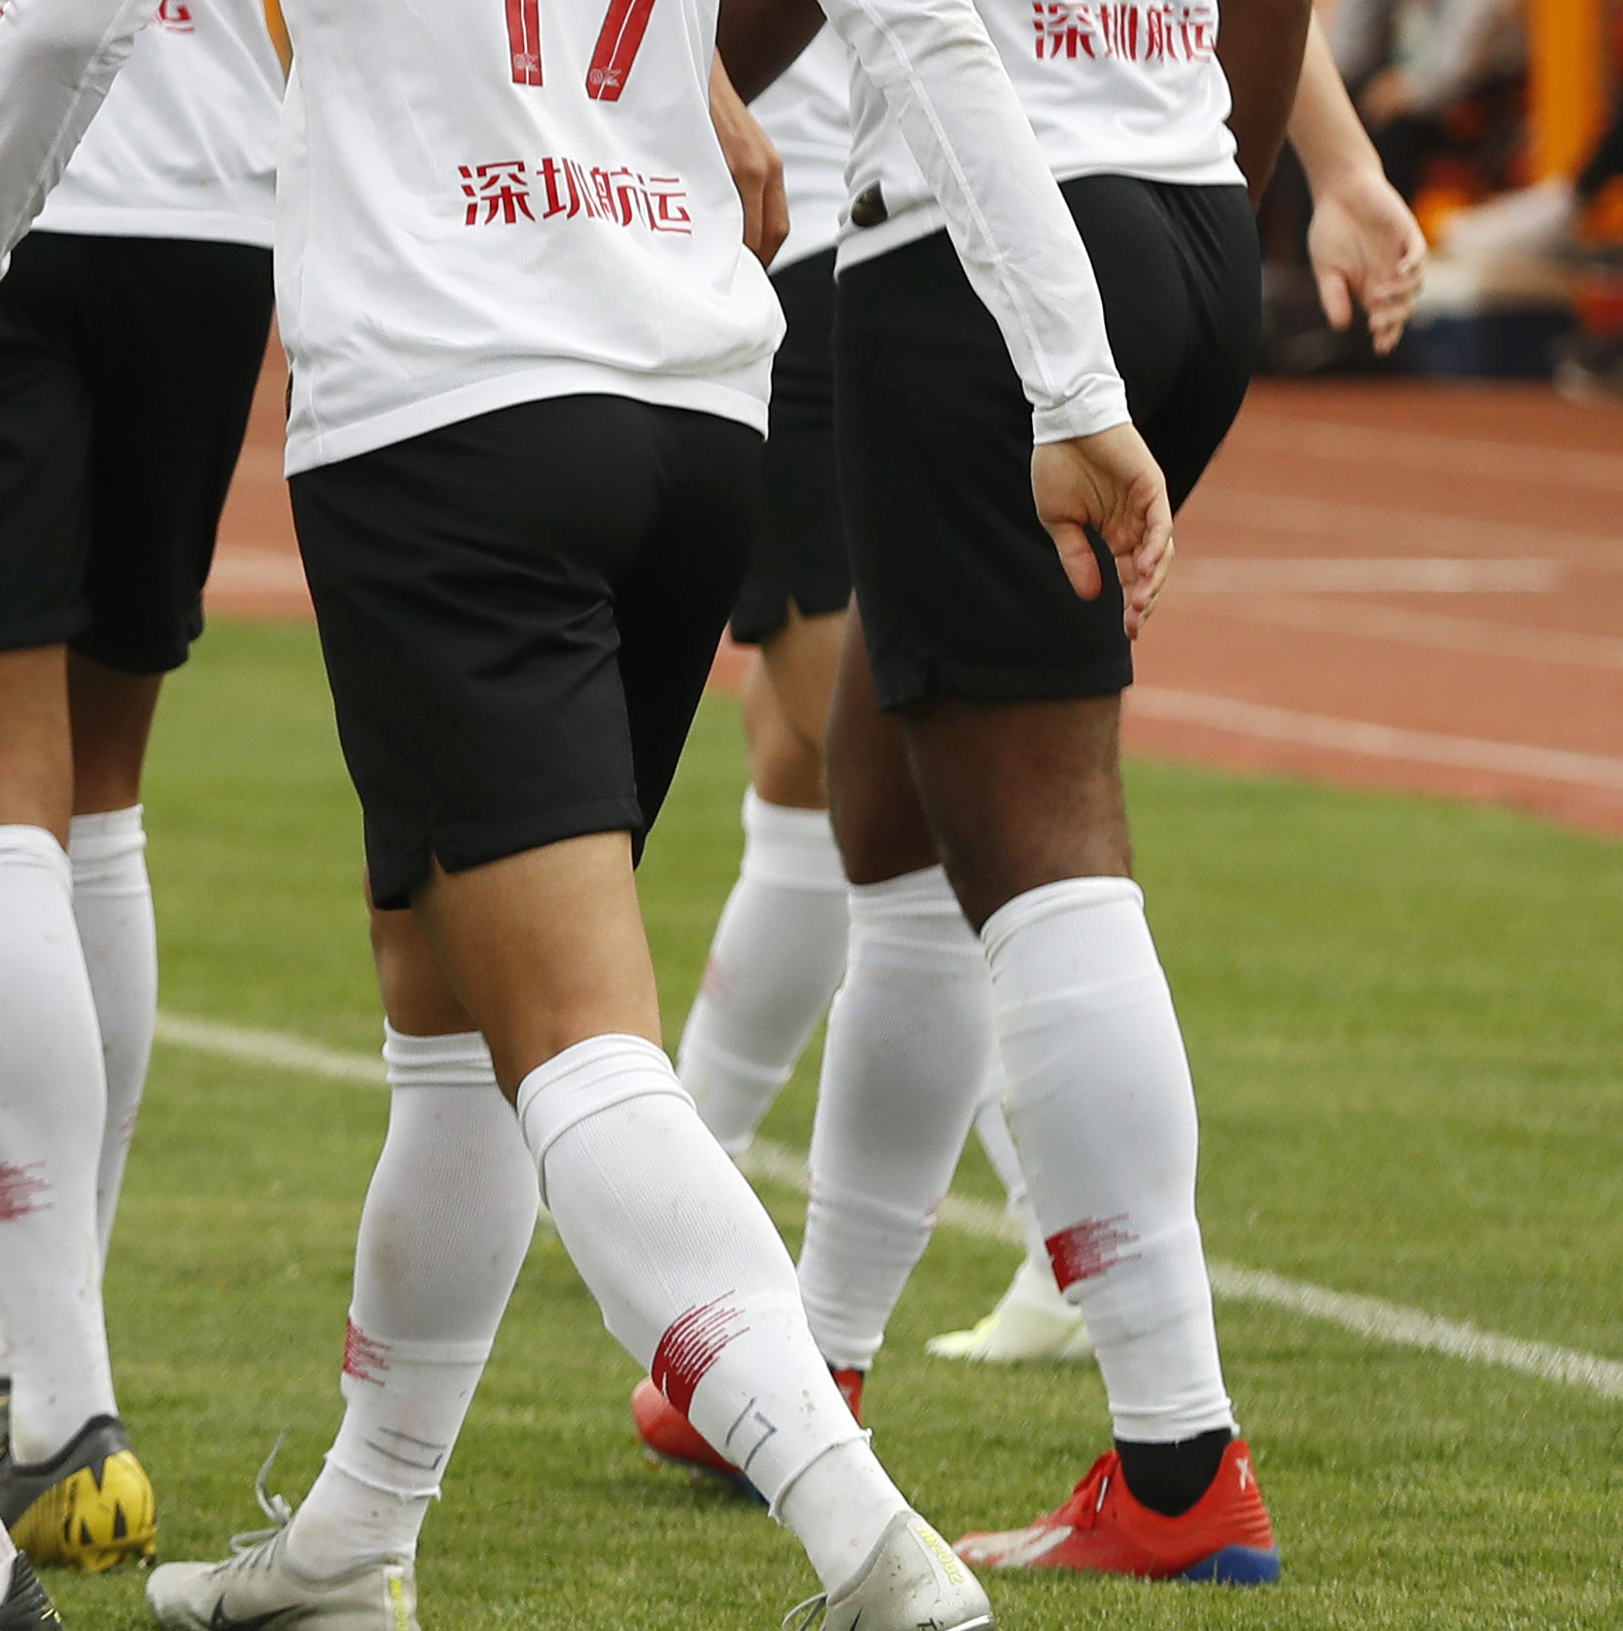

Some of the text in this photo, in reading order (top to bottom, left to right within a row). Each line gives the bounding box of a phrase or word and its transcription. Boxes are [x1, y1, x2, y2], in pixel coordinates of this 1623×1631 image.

[1032, 0, 1217, 63] 深圳航运
[458, 157, 694, 236] 深圳航运
